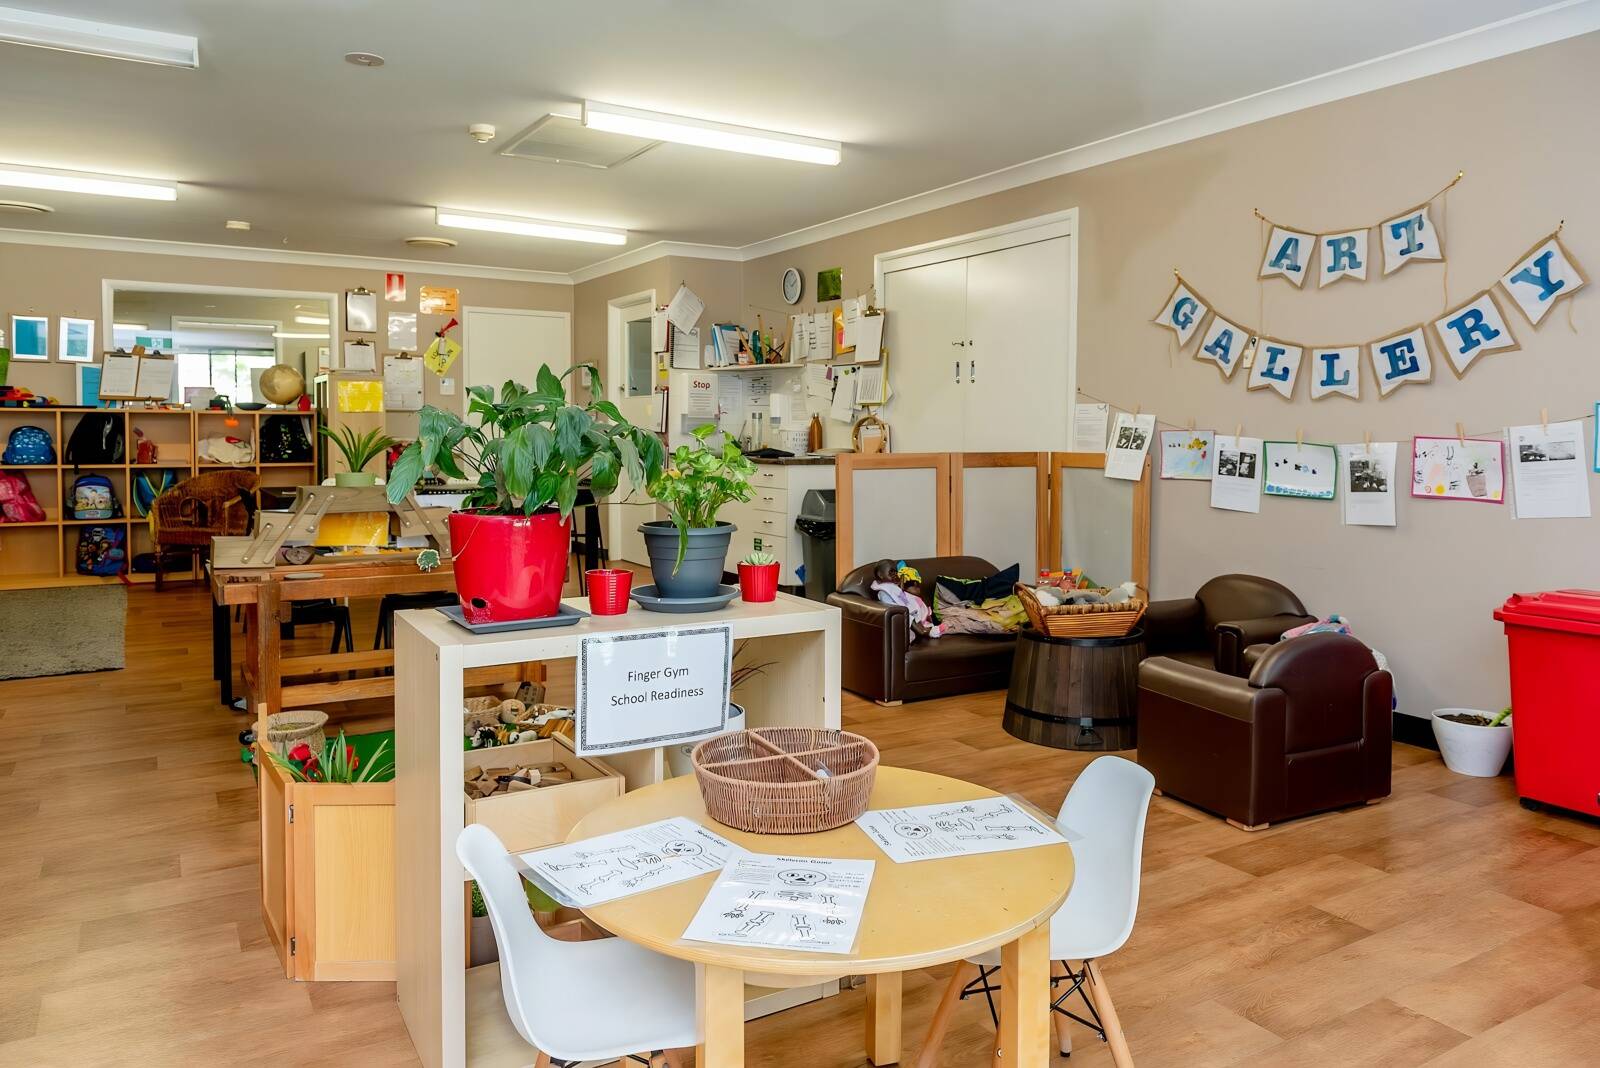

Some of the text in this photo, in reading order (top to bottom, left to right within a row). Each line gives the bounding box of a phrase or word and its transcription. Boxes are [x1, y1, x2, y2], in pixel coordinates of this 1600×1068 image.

[1268, 213, 1425, 273] ART
[1171, 250, 1565, 387] GALLERY
[693, 380, 711, 390] Stop
[628, 667, 689, 682] Finger Gym
[611, 687, 704, 706] School Readiness
